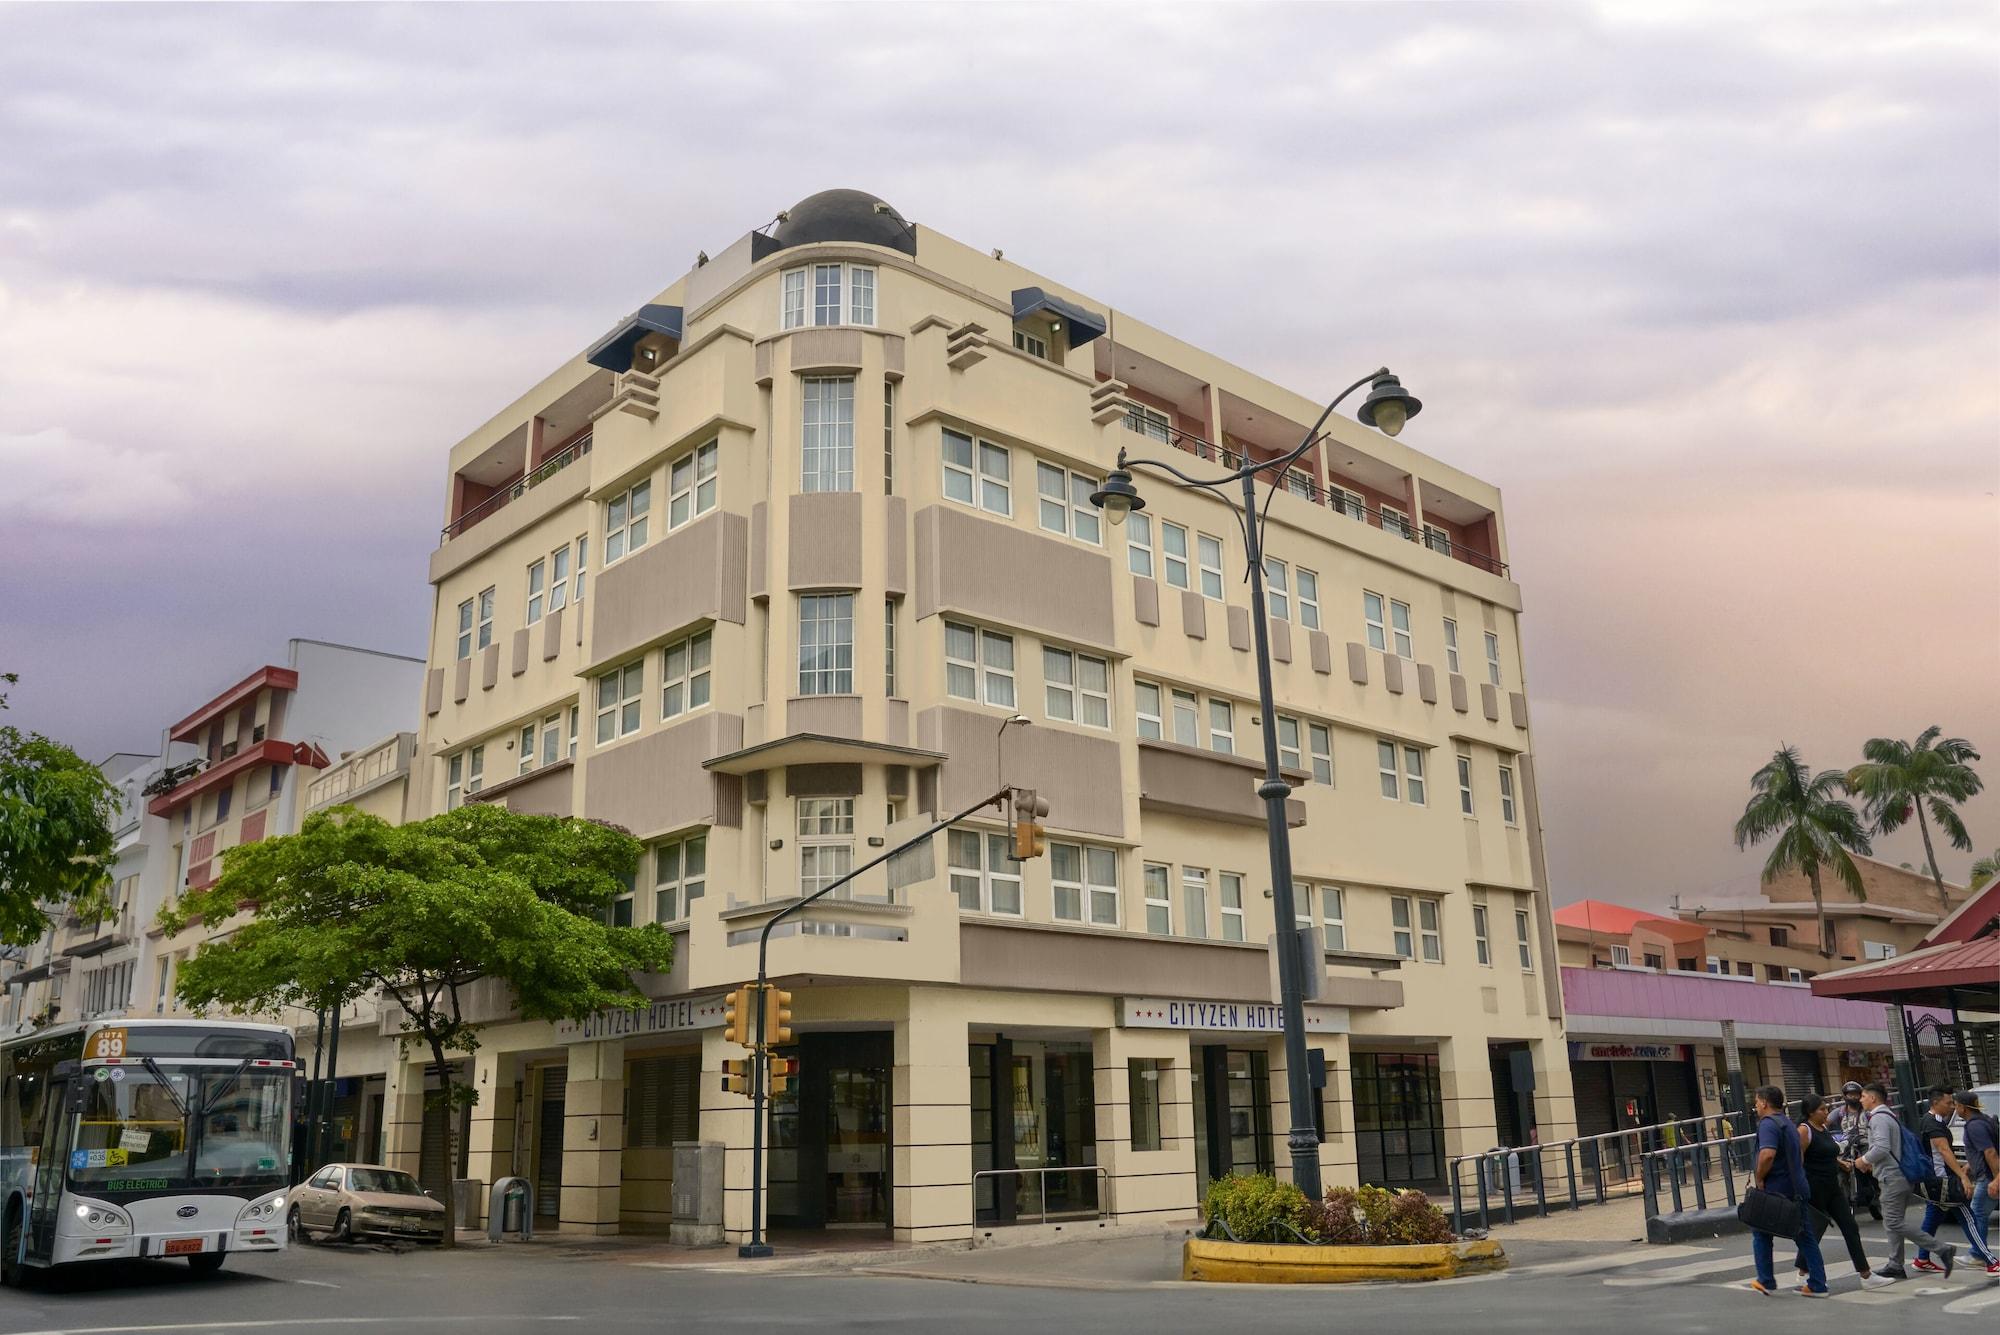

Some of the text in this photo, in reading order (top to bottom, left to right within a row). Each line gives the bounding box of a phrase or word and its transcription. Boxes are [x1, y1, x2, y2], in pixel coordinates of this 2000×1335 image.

[584, 1001, 694, 1038] CITYZEN HOTEL
[1169, 1002, 1284, 1029] CITYZEN HOTE
[98, 1031, 123, 1039] RUTA
[97, 1038, 123, 1057] 89
[107, 1179, 124, 1190] BUS
